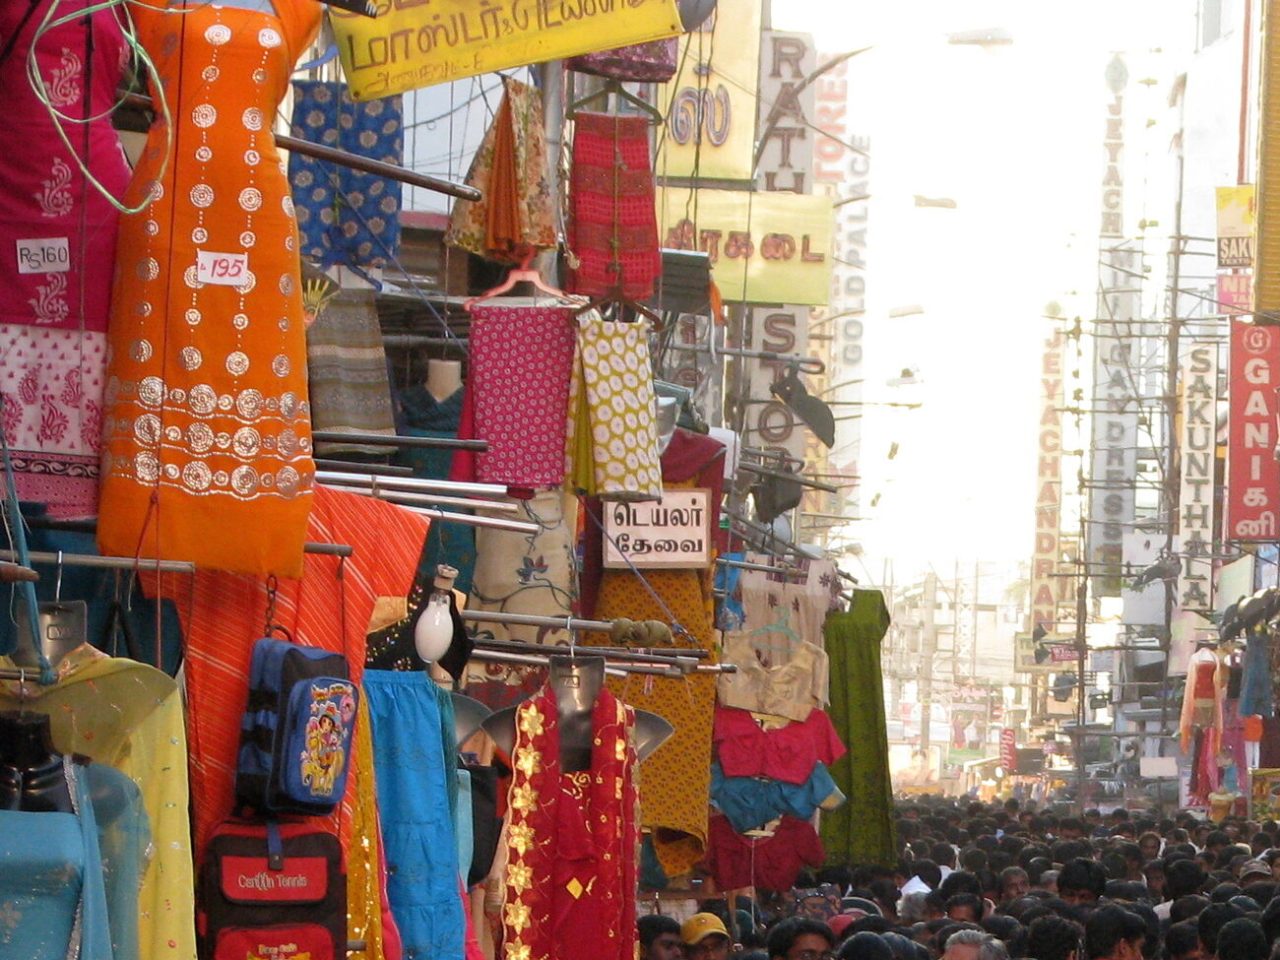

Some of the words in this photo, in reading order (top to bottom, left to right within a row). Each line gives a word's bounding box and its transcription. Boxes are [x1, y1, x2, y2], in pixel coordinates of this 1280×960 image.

[844, 134, 871, 268] PALACE
[842, 276, 867, 366] GOLD
[1243, 358, 1270, 481] GANI
[614, 498, 703, 527] டெய்லர்
[1183, 349, 1211, 607] SAKUNTHALA
[615, 533, 703, 557] தேவை
